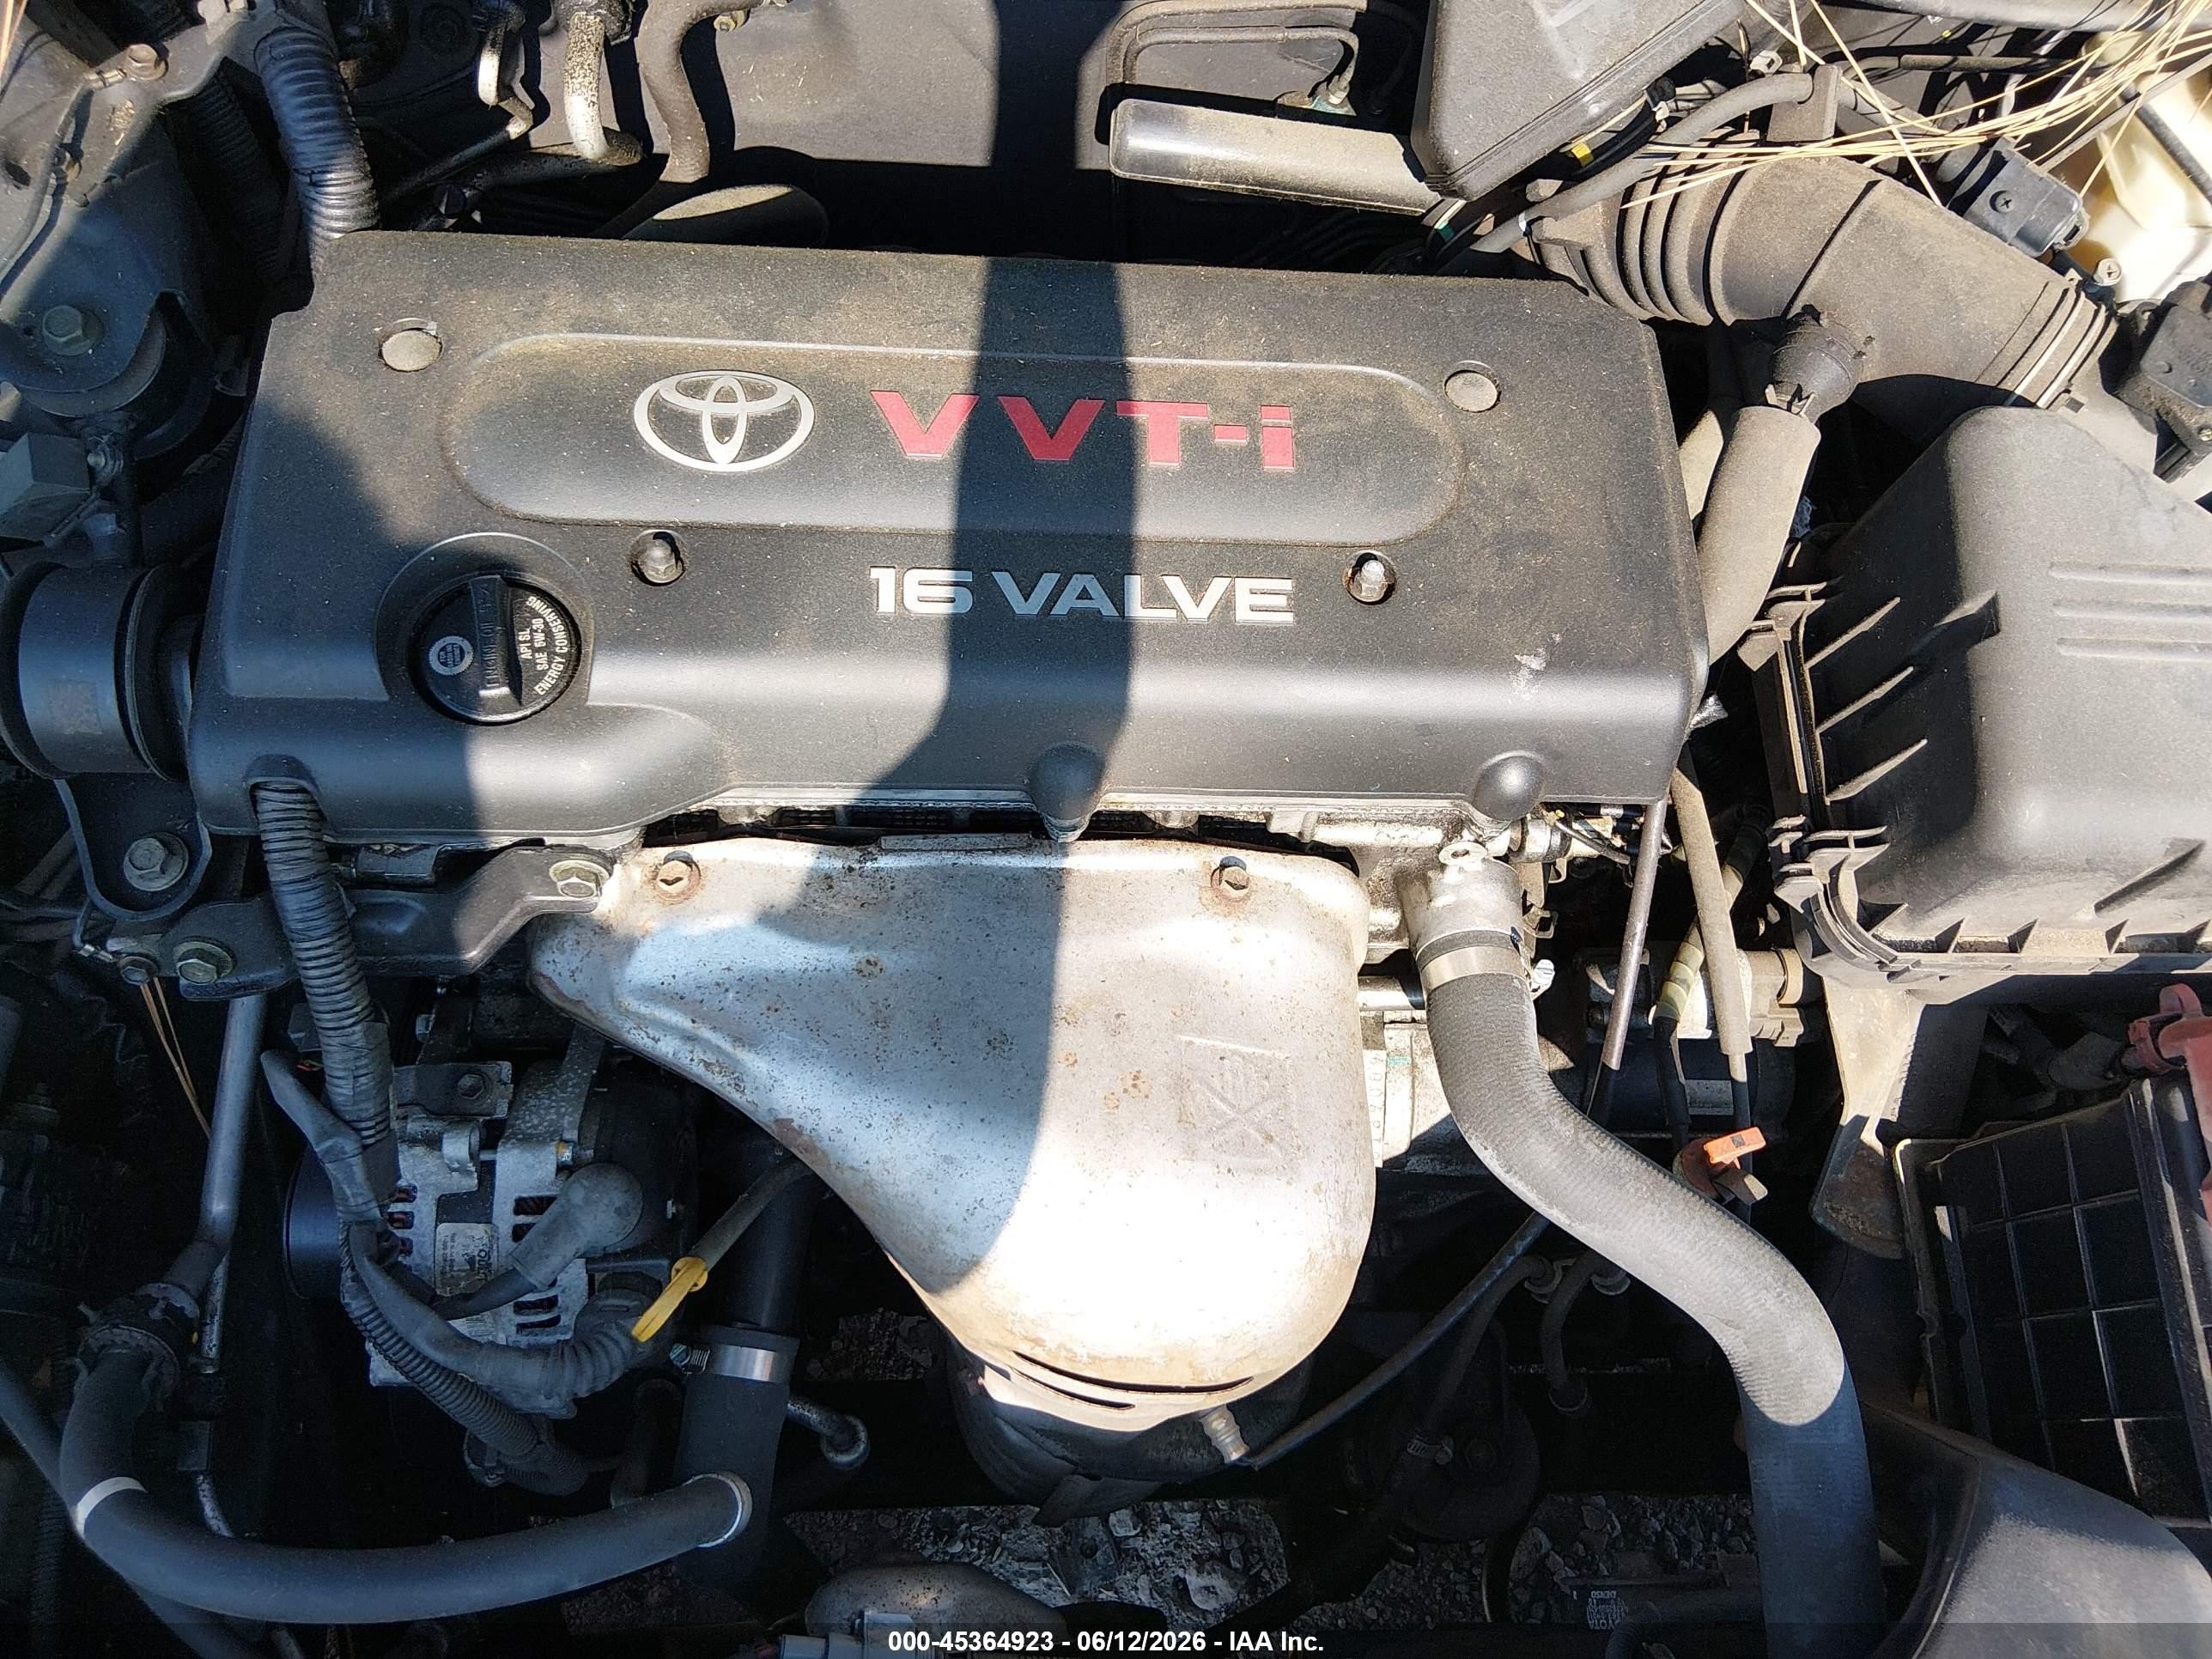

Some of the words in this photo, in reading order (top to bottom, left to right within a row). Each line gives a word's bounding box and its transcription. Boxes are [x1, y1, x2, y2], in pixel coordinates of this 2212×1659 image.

[870, 565, 974, 616] 16
[992, 570, 1295, 625] VALVE
[518, 628, 531, 641] SL
[526, 595, 569, 654] CONSERVING
[532, 617, 547, 648] 5W-30
[520, 642, 533, 659] API
[535, 651, 550, 672] SAE
[532, 655, 567, 696] ENERGY
